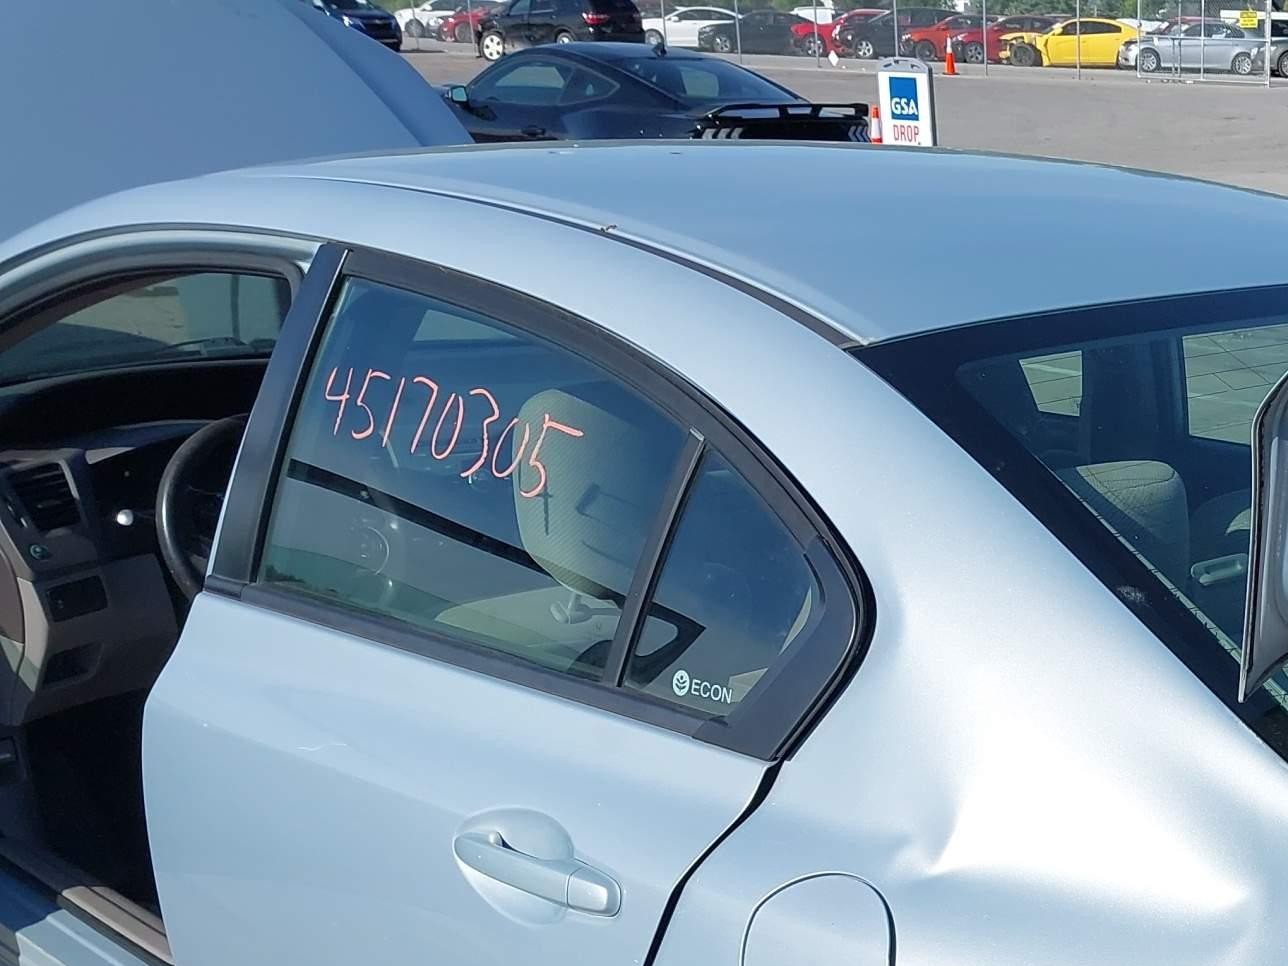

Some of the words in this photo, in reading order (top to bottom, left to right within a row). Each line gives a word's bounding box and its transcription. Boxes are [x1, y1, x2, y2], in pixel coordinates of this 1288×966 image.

[891, 97, 918, 115] GSA
[892, 124, 920, 143] DROP
[324, 367, 585, 498] 45170305
[691, 679, 733, 704] ECON
